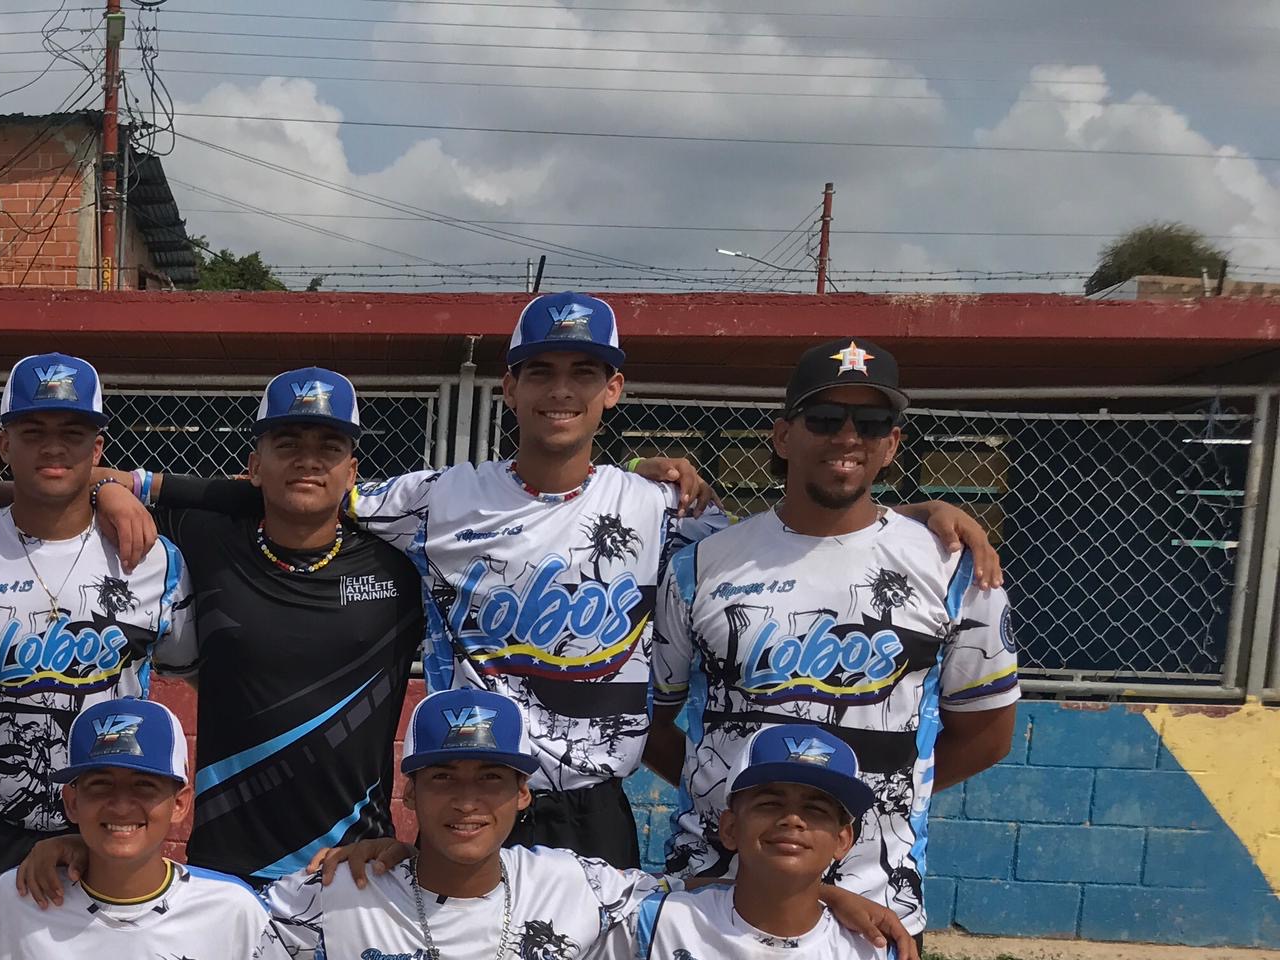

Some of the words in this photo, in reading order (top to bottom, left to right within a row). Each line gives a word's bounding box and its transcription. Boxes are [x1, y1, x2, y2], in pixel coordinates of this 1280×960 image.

[346, 575, 376, 586] ELITE
[346, 580, 395, 593] ATHLETE
[451, 554, 643, 651] Lobos
[736, 615, 903, 689] Lobos
